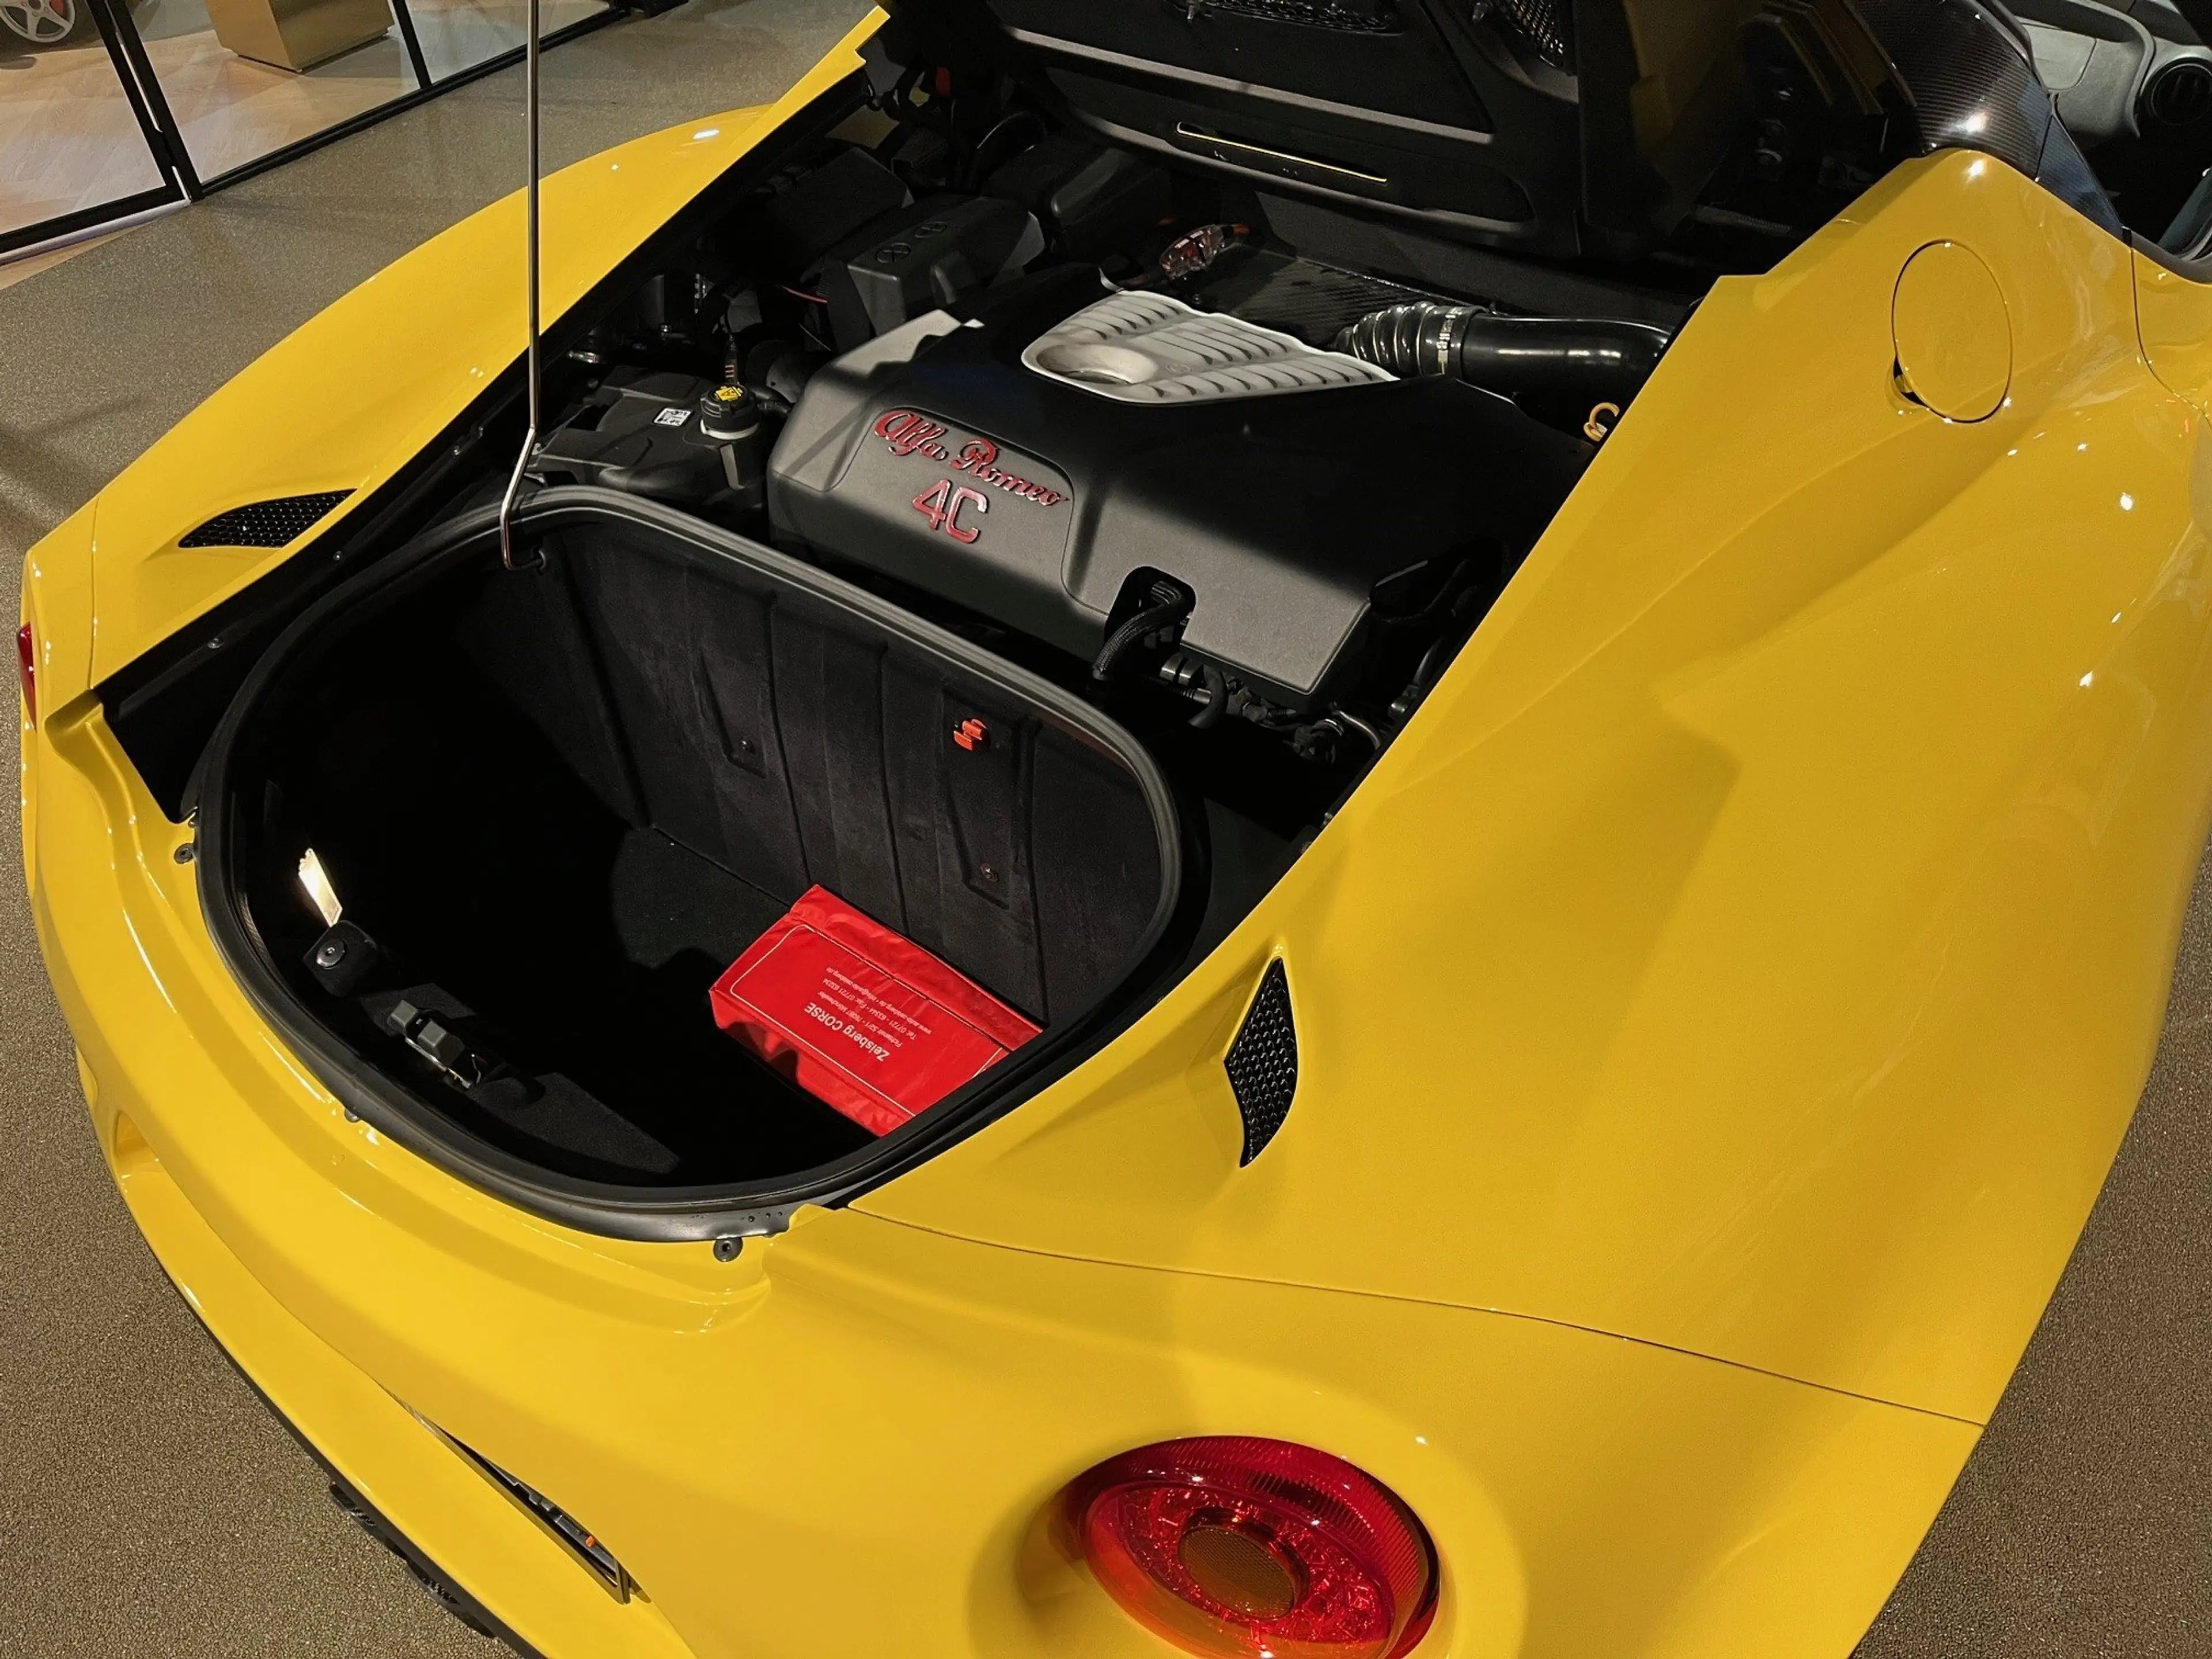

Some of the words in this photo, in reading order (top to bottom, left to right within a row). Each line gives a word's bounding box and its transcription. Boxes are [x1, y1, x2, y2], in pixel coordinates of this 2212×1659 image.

[874, 410, 948, 461] Alfa
[950, 437, 1067, 506] Romeo
[912, 478, 989, 543] 4C
[804, 1002, 843, 1031] CORSE
[842, 1025, 890, 1062] Zeisberg
